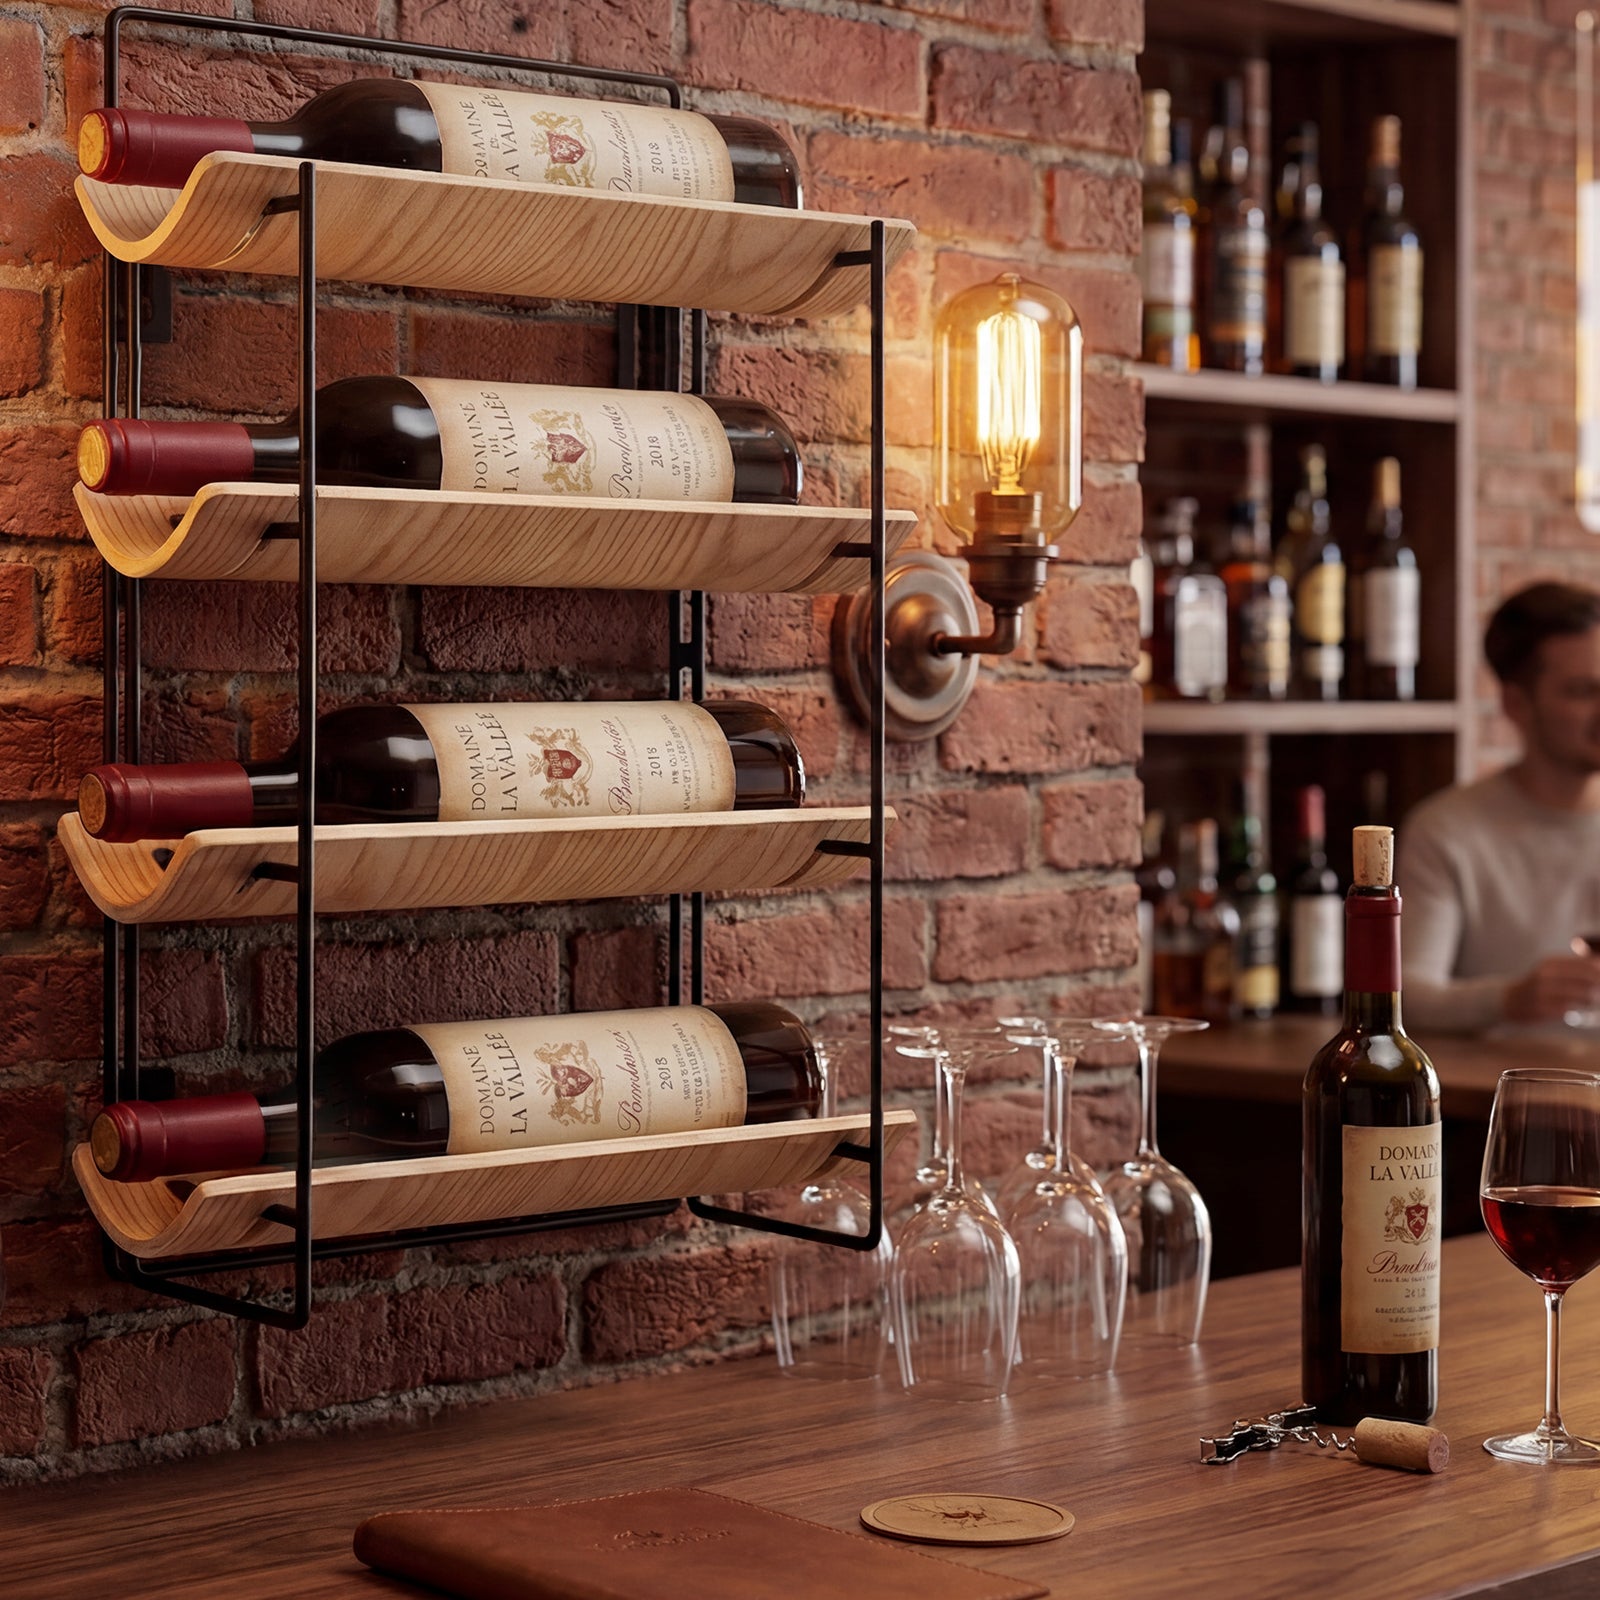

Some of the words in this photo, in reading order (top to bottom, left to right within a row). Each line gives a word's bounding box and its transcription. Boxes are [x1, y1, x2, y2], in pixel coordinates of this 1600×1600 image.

[505, 164, 520, 183] A
[458, 401, 488, 489] DOMAINE
[647, 436, 665, 469] 2018
[502, 466, 520, 492] LA
[475, 712, 517, 781] VALLÉE
[646, 747, 663, 778] 2018
[455, 723, 487, 811] DOMAINE
[500, 786, 519, 812] LA
[484, 1032, 526, 1101] VALLÉE
[654, 1057, 674, 1090] 2018
[462, 1045, 496, 1135] DOMAINE
[509, 1108, 528, 1135] LA
[1369, 1165, 1394, 1181] LA
